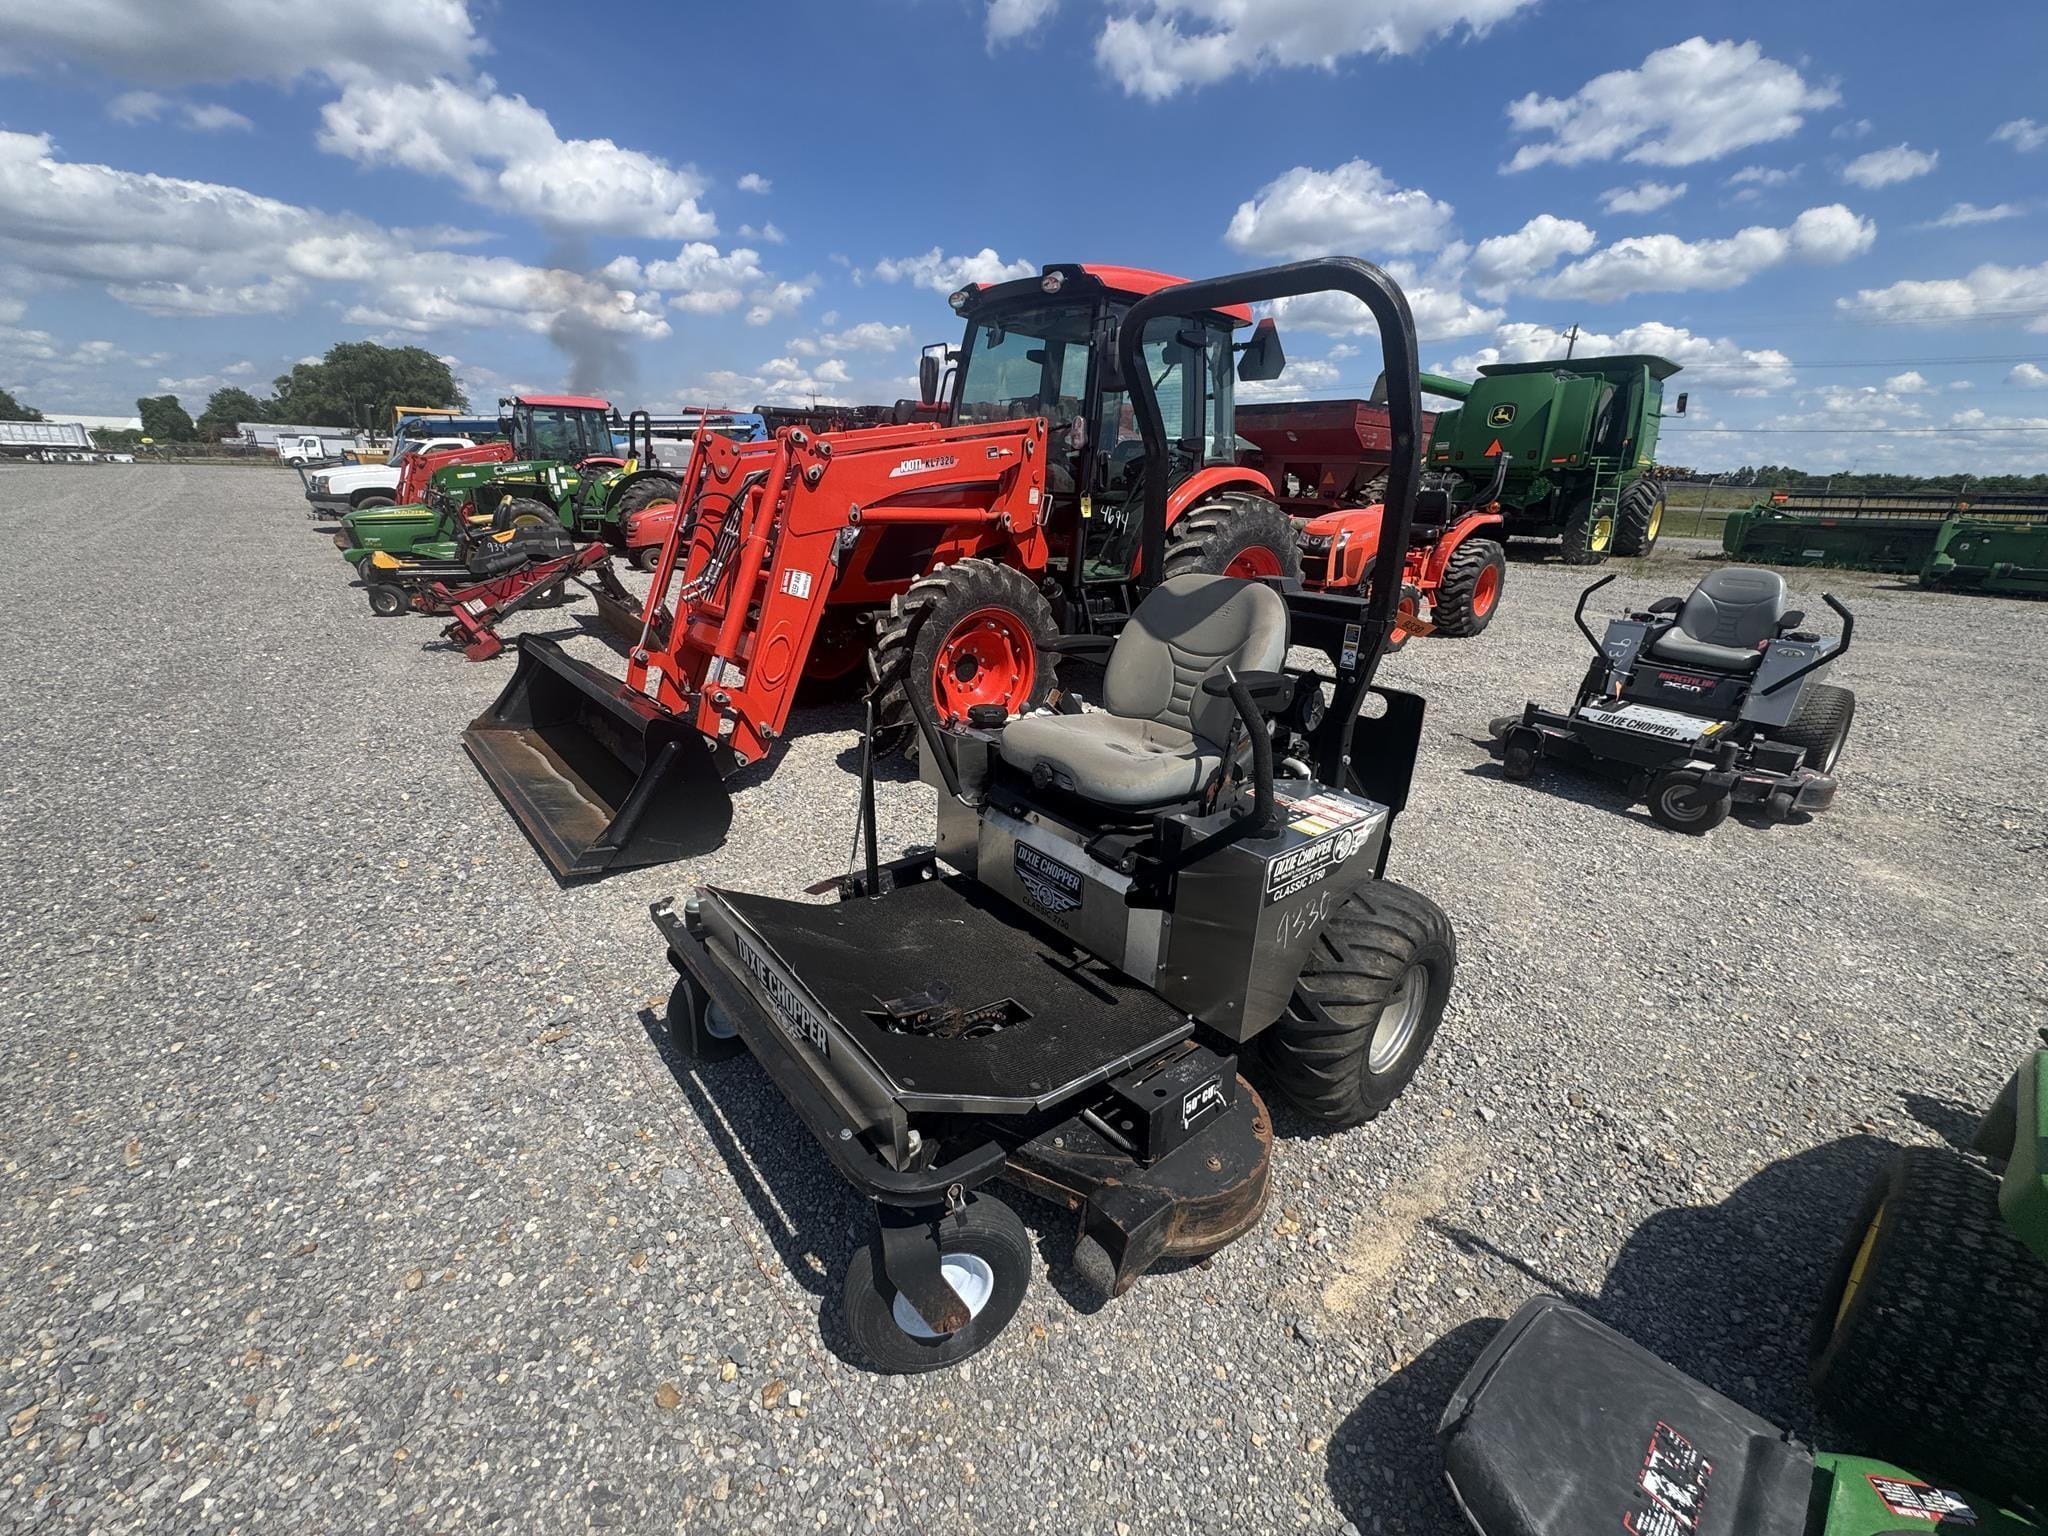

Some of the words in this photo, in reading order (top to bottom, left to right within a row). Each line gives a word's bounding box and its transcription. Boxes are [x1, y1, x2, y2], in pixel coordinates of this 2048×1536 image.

[925, 455, 955, 468] KL7320
[1100, 504, 1130, 536] 4694
[1401, 620, 1425, 634] 9330
[1597, 713, 1628, 727] DIXIE
[1626, 719, 1678, 737] CHOPPER
[1017, 846, 1040, 868] DIXIE
[1040, 858, 1080, 890] CHOPPER
[1273, 853, 1299, 878] DIXIE
[1296, 838, 1334, 867] CHOPPER
[1273, 877, 1308, 901] CLASSIC
[1308, 868, 1326, 885] 2750
[1022, 895, 1052, 919] CLASSIC
[1276, 890, 1331, 949] 9330
[737, 937, 768, 987] DIXIE
[768, 971, 827, 1055] CHOPPER
